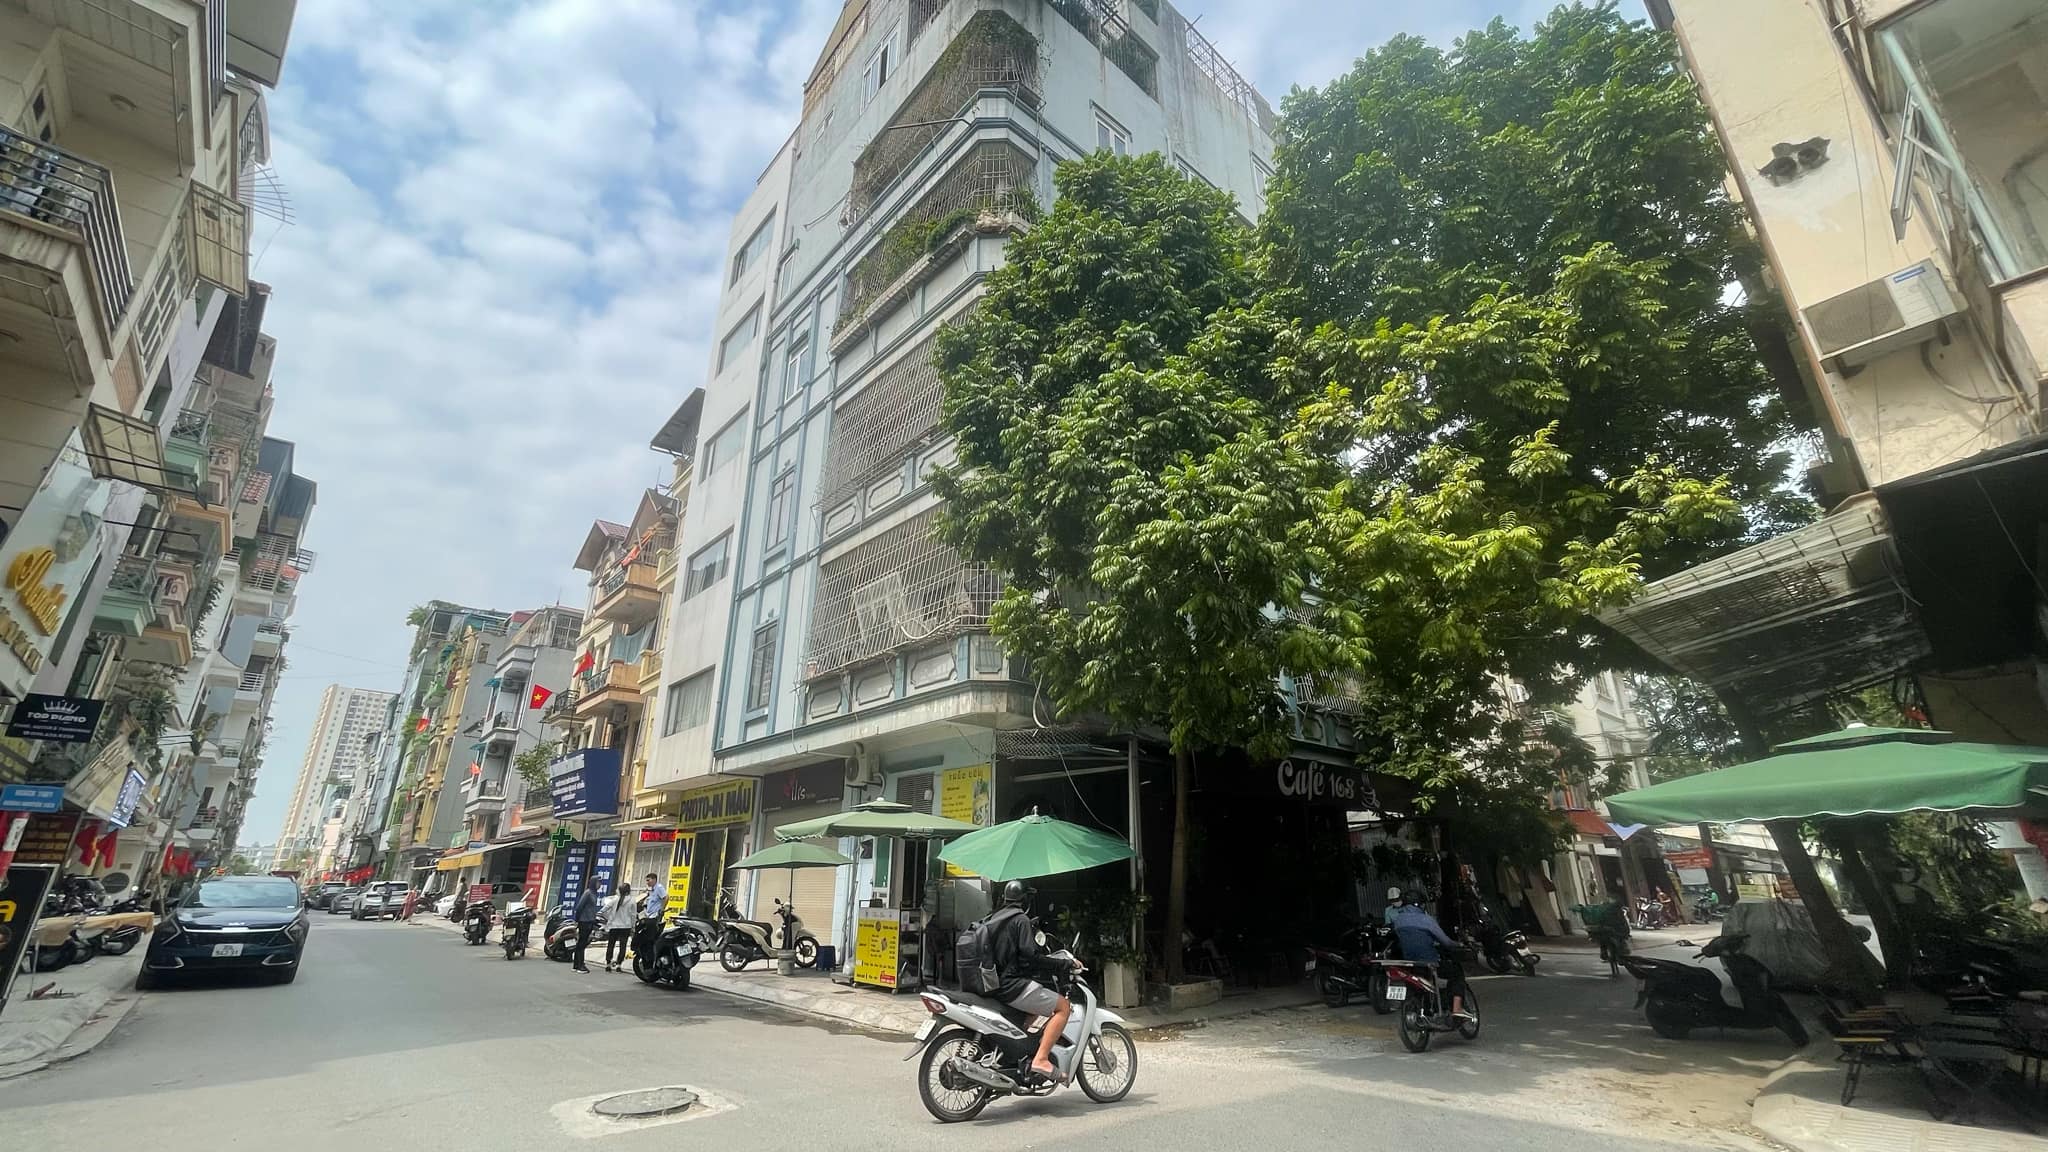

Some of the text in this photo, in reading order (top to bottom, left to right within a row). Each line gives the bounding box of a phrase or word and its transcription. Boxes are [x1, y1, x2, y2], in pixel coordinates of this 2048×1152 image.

[27, 711, 87, 723] TOP PIANO
[1277, 759, 1355, 801] Café 168
[673, 838, 694, 867] IN
